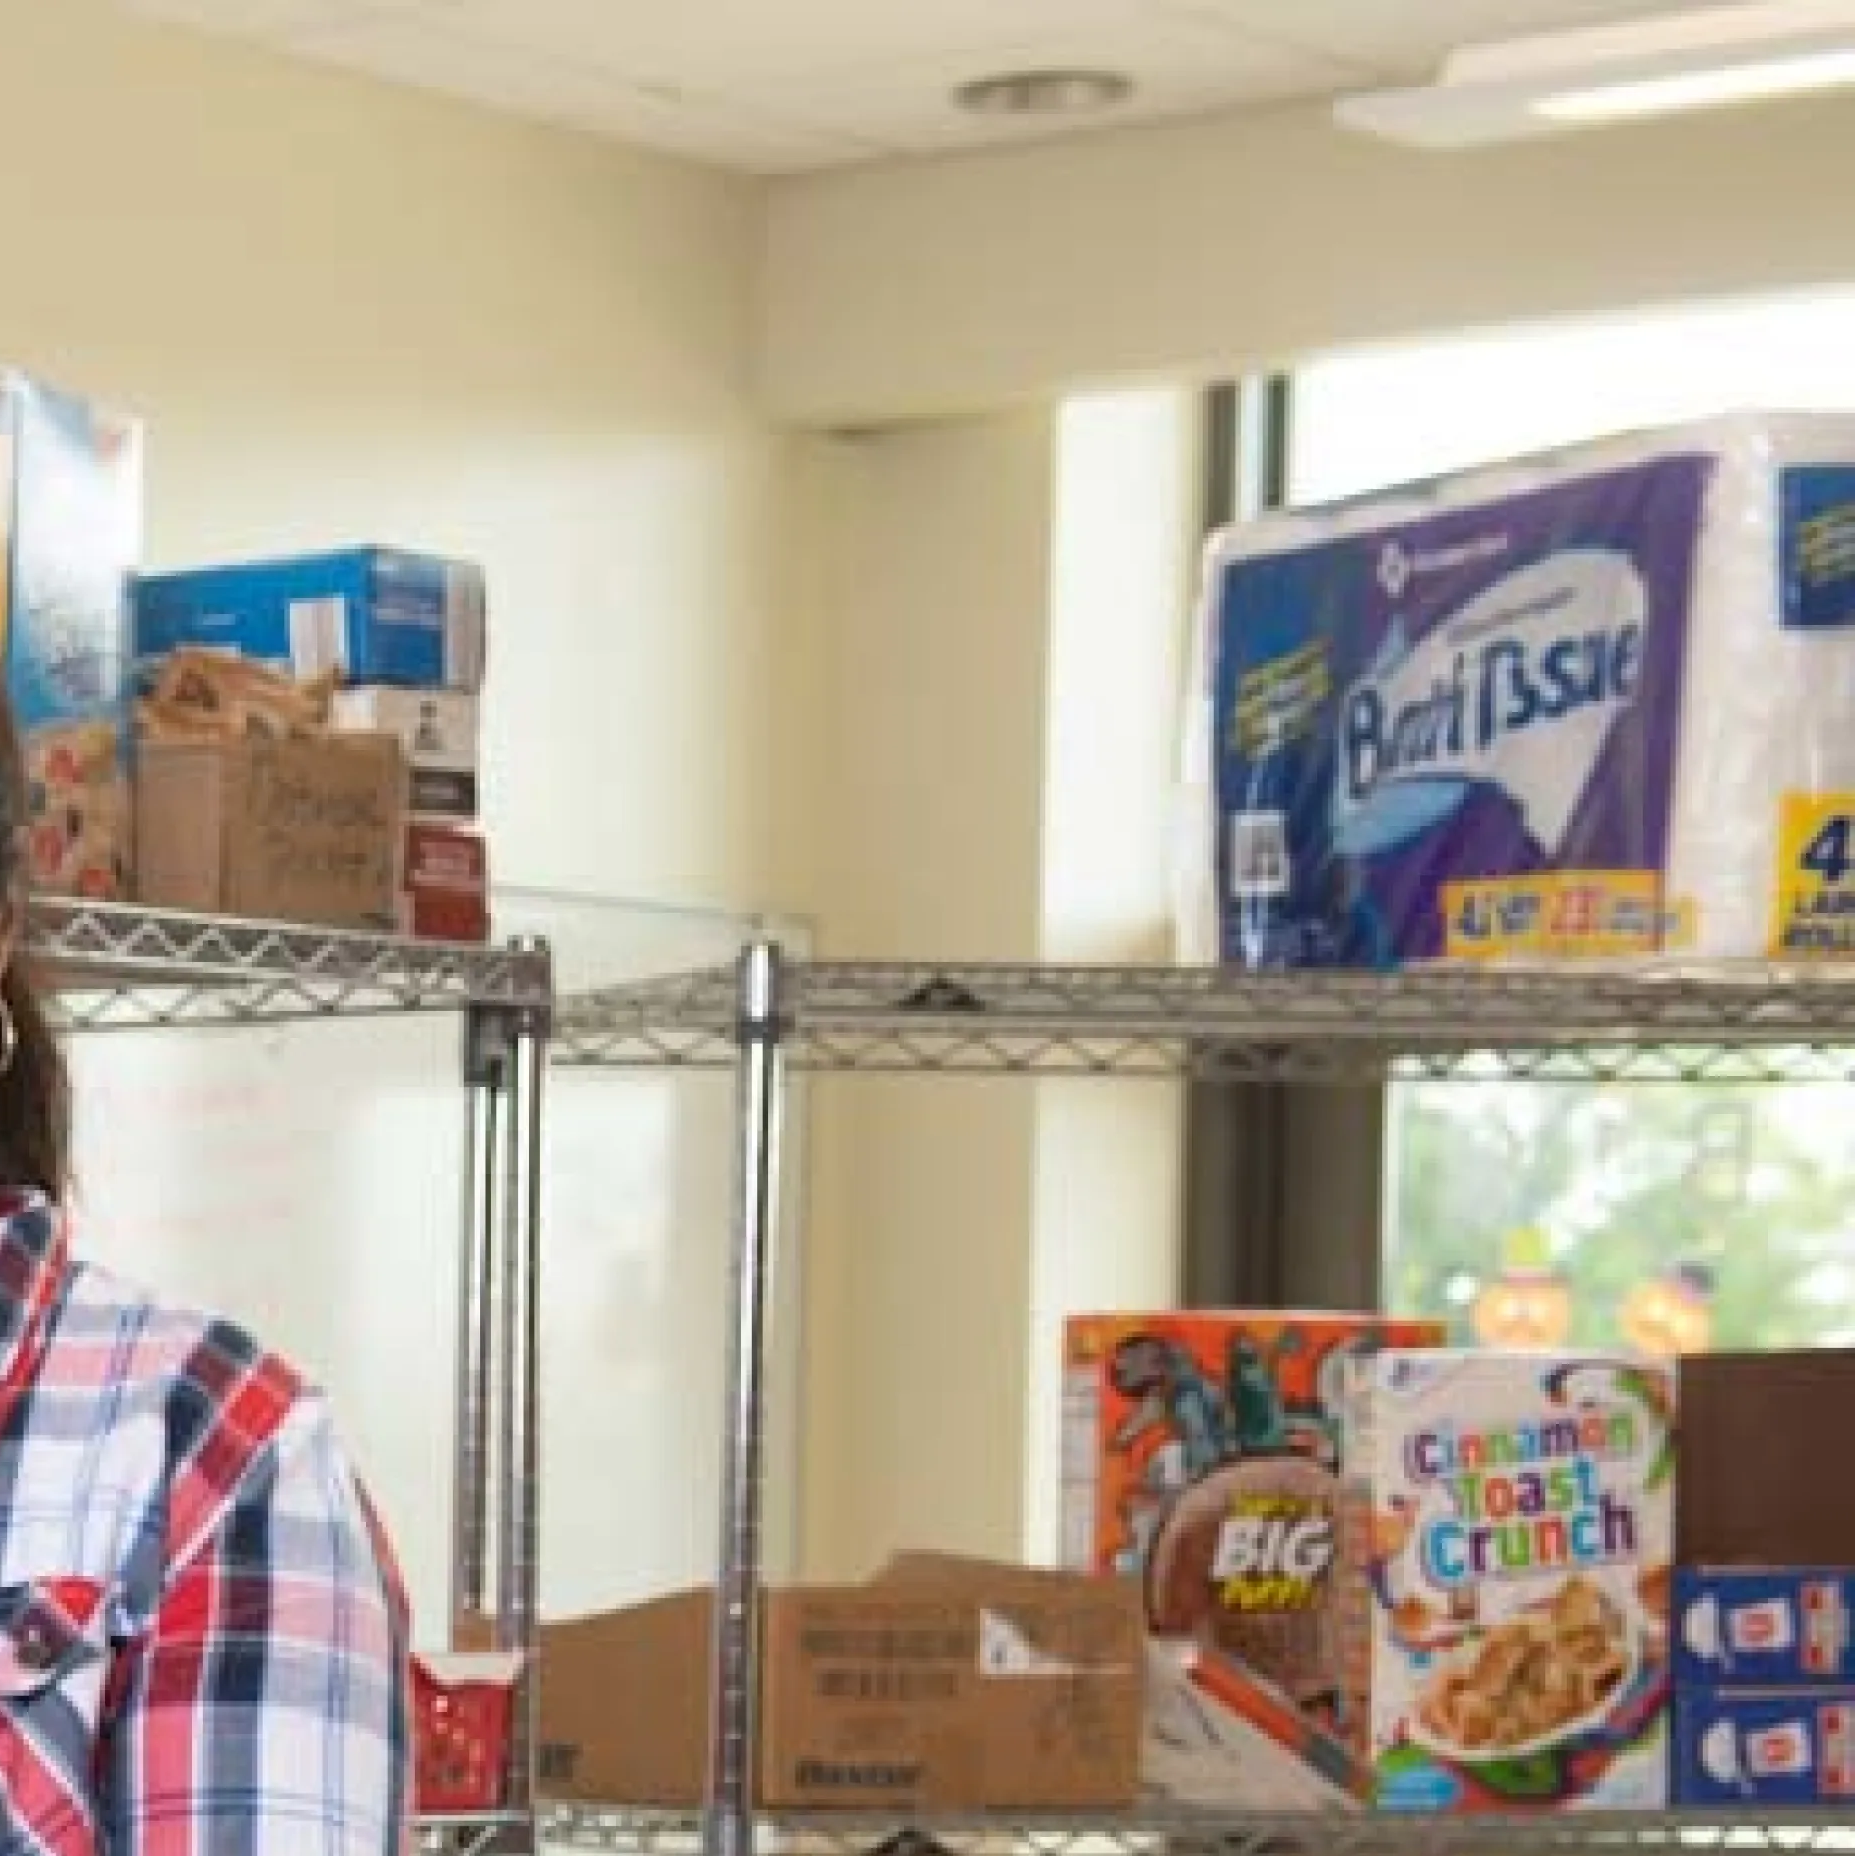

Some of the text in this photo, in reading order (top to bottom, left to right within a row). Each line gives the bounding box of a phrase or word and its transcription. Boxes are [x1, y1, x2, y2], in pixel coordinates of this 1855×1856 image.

[1412, 1411, 1635, 1476] Cinnamon
[1456, 1453, 1598, 1521] Toast
[1211, 1514, 1331, 1581] BIG
[1426, 1485, 1634, 1580] Crunch
